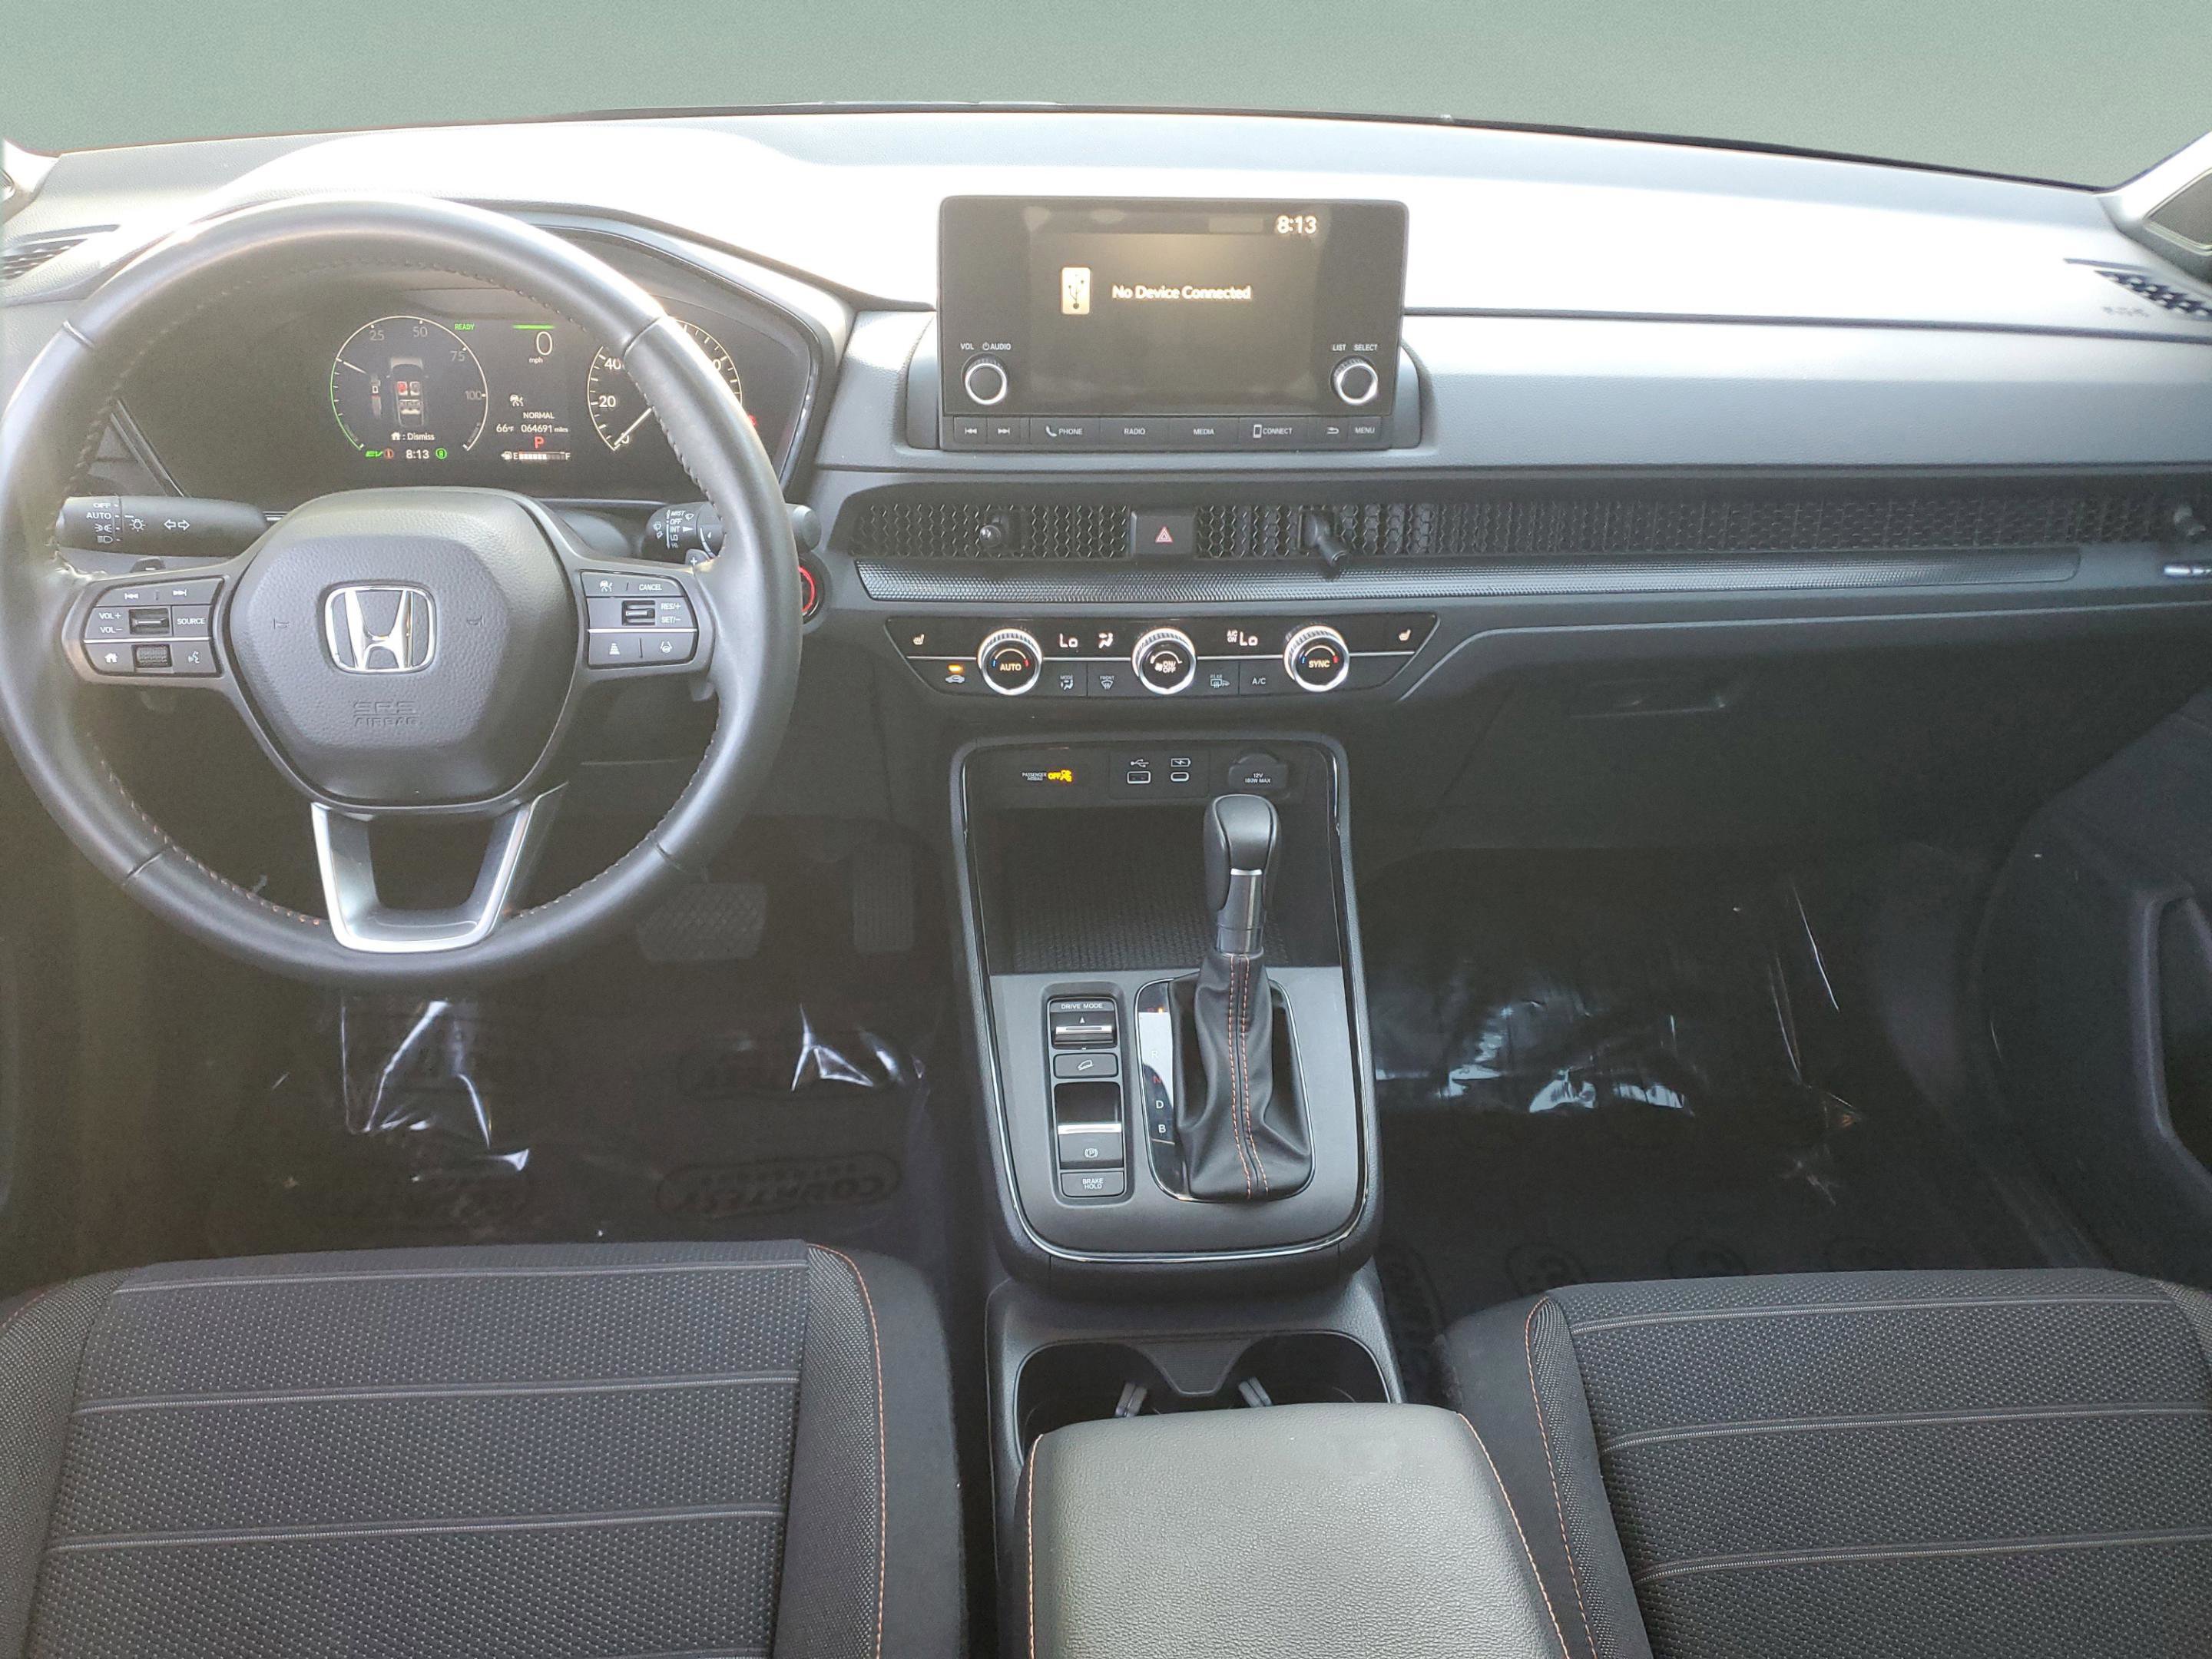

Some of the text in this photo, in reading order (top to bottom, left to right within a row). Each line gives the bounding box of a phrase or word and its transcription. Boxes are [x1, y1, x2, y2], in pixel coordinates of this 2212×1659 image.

[1277, 215, 1317, 233] 8:13
[1112, 285, 1251, 299] No Device Connected
[369, 330, 384, 340] 25
[413, 327, 428, 337] 50
[536, 331, 553, 356] 0
[450, 351, 465, 362] 75
[604, 359, 621, 370] 40
[465, 390, 482, 399] 100
[598, 396, 616, 408] 20
[521, 424, 552, 433] 064691
[407, 432, 435, 441] Dismiss
[534, 436, 545, 449] P
[406, 449, 429, 459] 8:13
[86, 512, 112, 520] AUTO
[177, 617, 206, 625] SOURCE
[1000, 663, 1022, 671] AUTO
[1151, 1050, 1159, 1059] R
[1156, 1100, 1164, 1109] D
[1158, 1124, 1167, 1134] B
